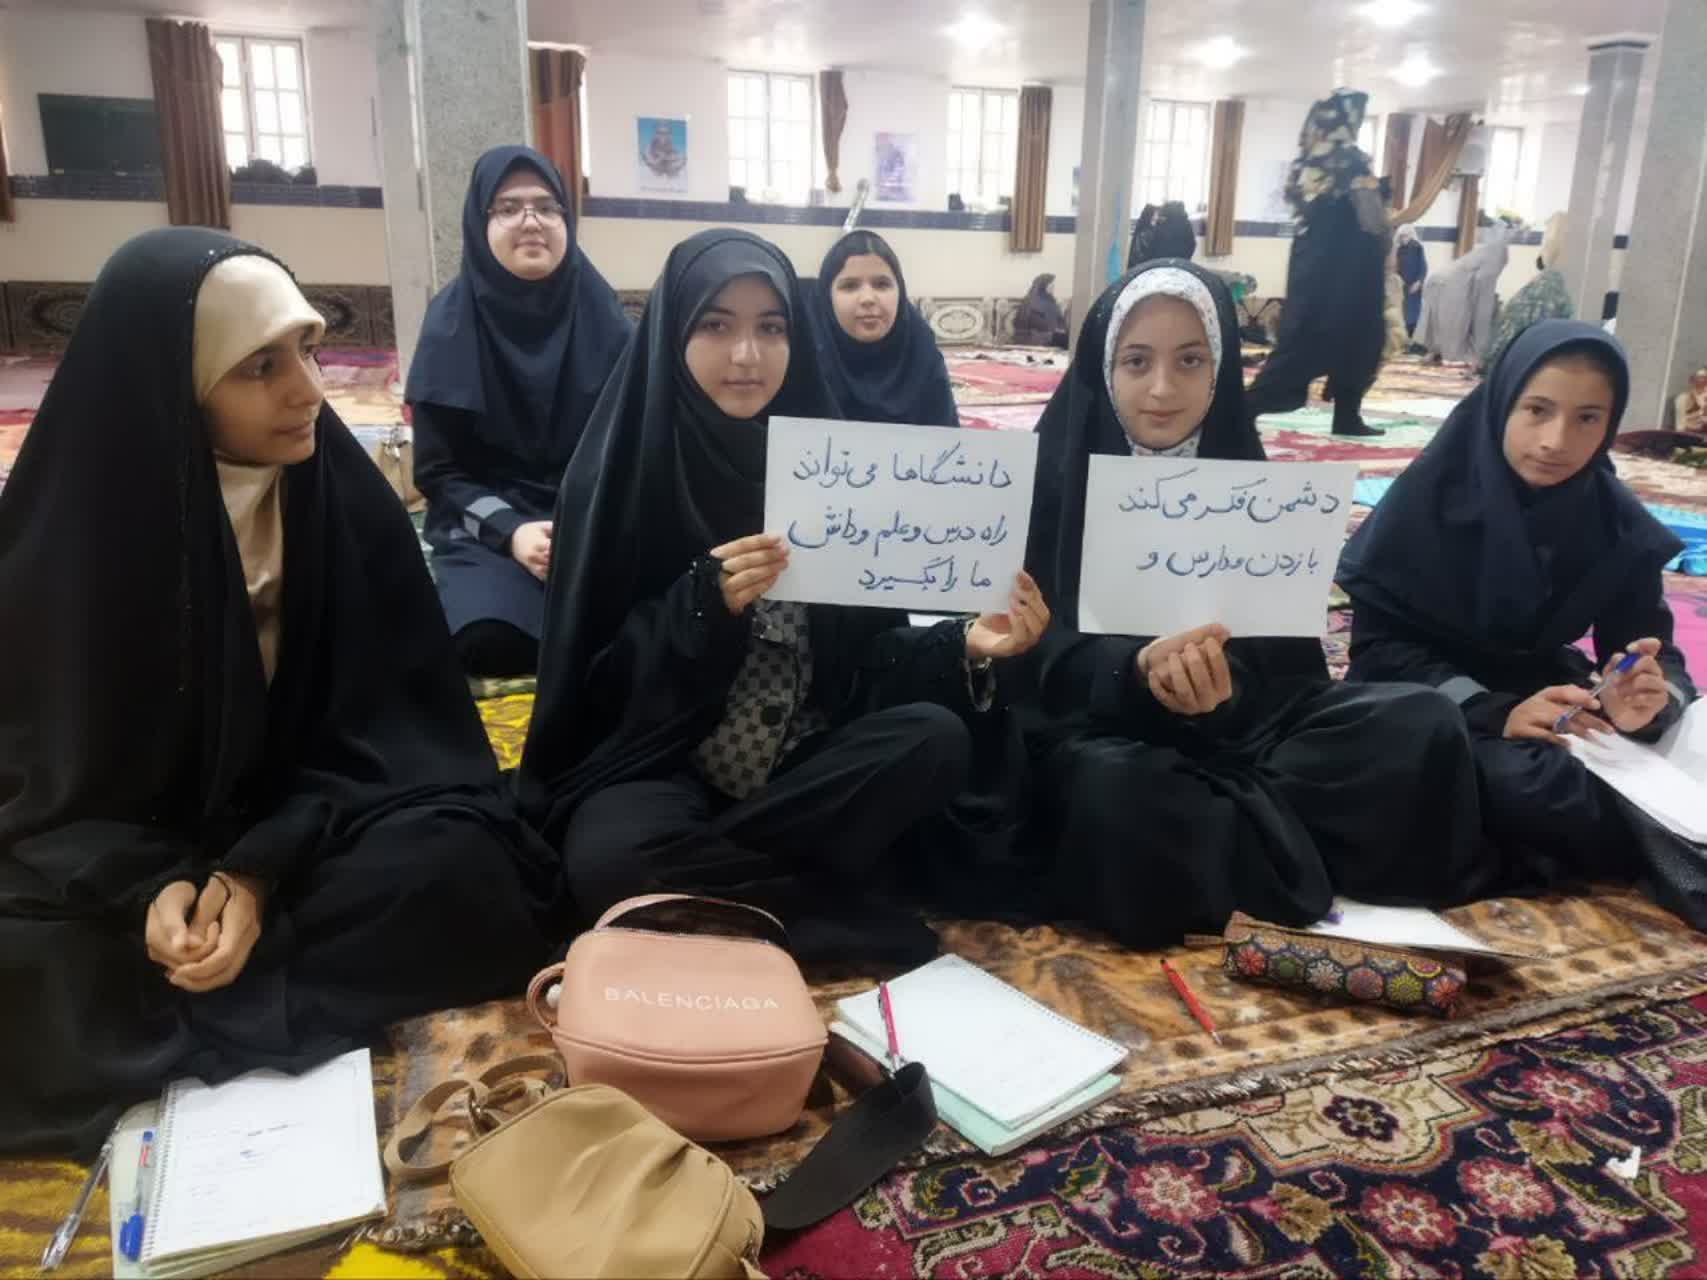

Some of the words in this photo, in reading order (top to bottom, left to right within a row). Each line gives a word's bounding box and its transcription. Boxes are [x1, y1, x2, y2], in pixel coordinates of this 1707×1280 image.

[1194, 477, 1268, 520] فکر
[1247, 480, 1340, 523] دشمن
[787, 505, 858, 549] دانش
[874, 510, 913, 557] علم
[923, 523, 976, 545] درس
[980, 514, 1008, 546] راه
[858, 555, 953, 591] بگیرد
[939, 557, 959, 593] را
[970, 560, 992, 588] ما
[1136, 551, 1159, 570] و
[1166, 544, 1246, 578] مدارس
[1245, 553, 1304, 577] زدن
[1308, 547, 1319, 574] با
[604, 985, 780, 1011] BALENCIAGA
